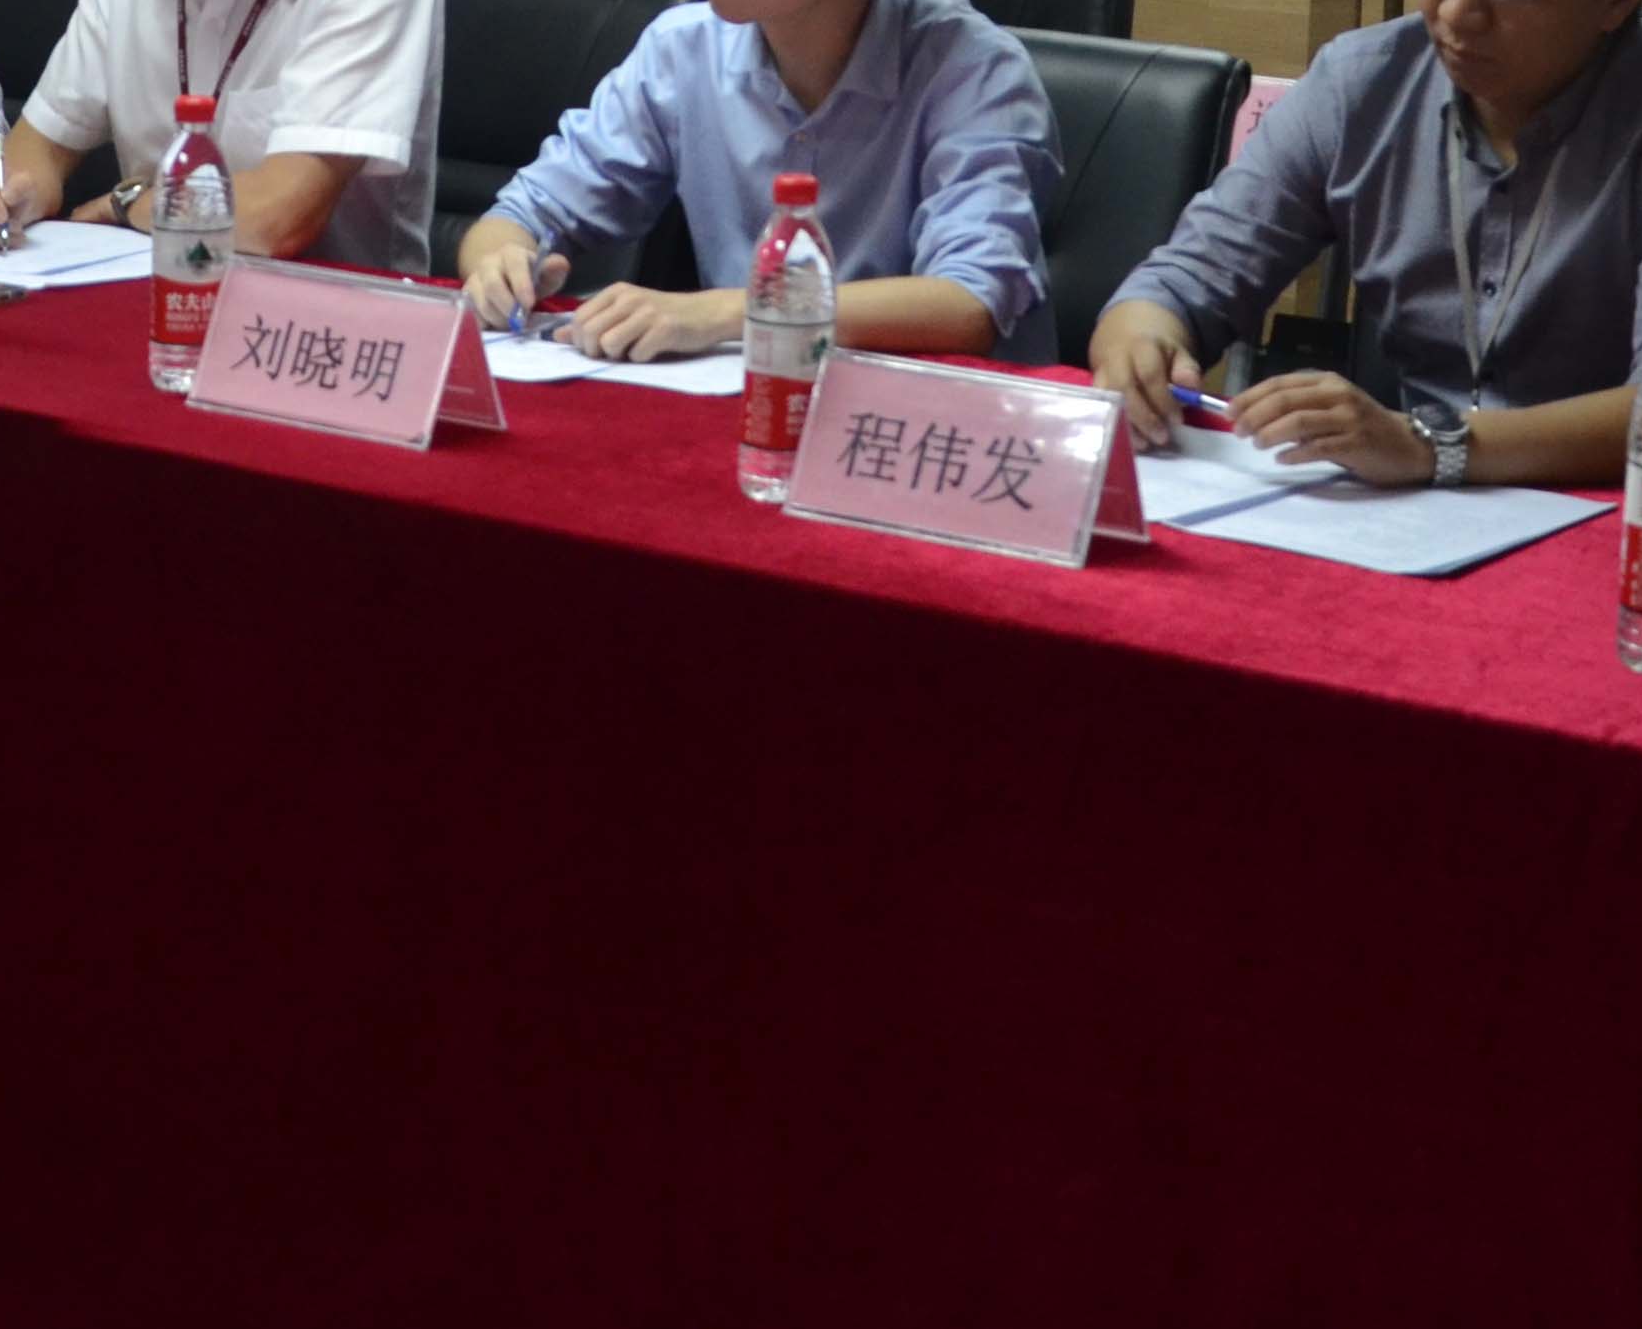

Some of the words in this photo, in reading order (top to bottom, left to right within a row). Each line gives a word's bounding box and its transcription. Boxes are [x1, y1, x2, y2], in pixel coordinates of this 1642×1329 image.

[165, 291, 216, 312] 农夫山
[228, 312, 405, 401] 刘晓明
[836, 411, 1043, 511] 程伟发
